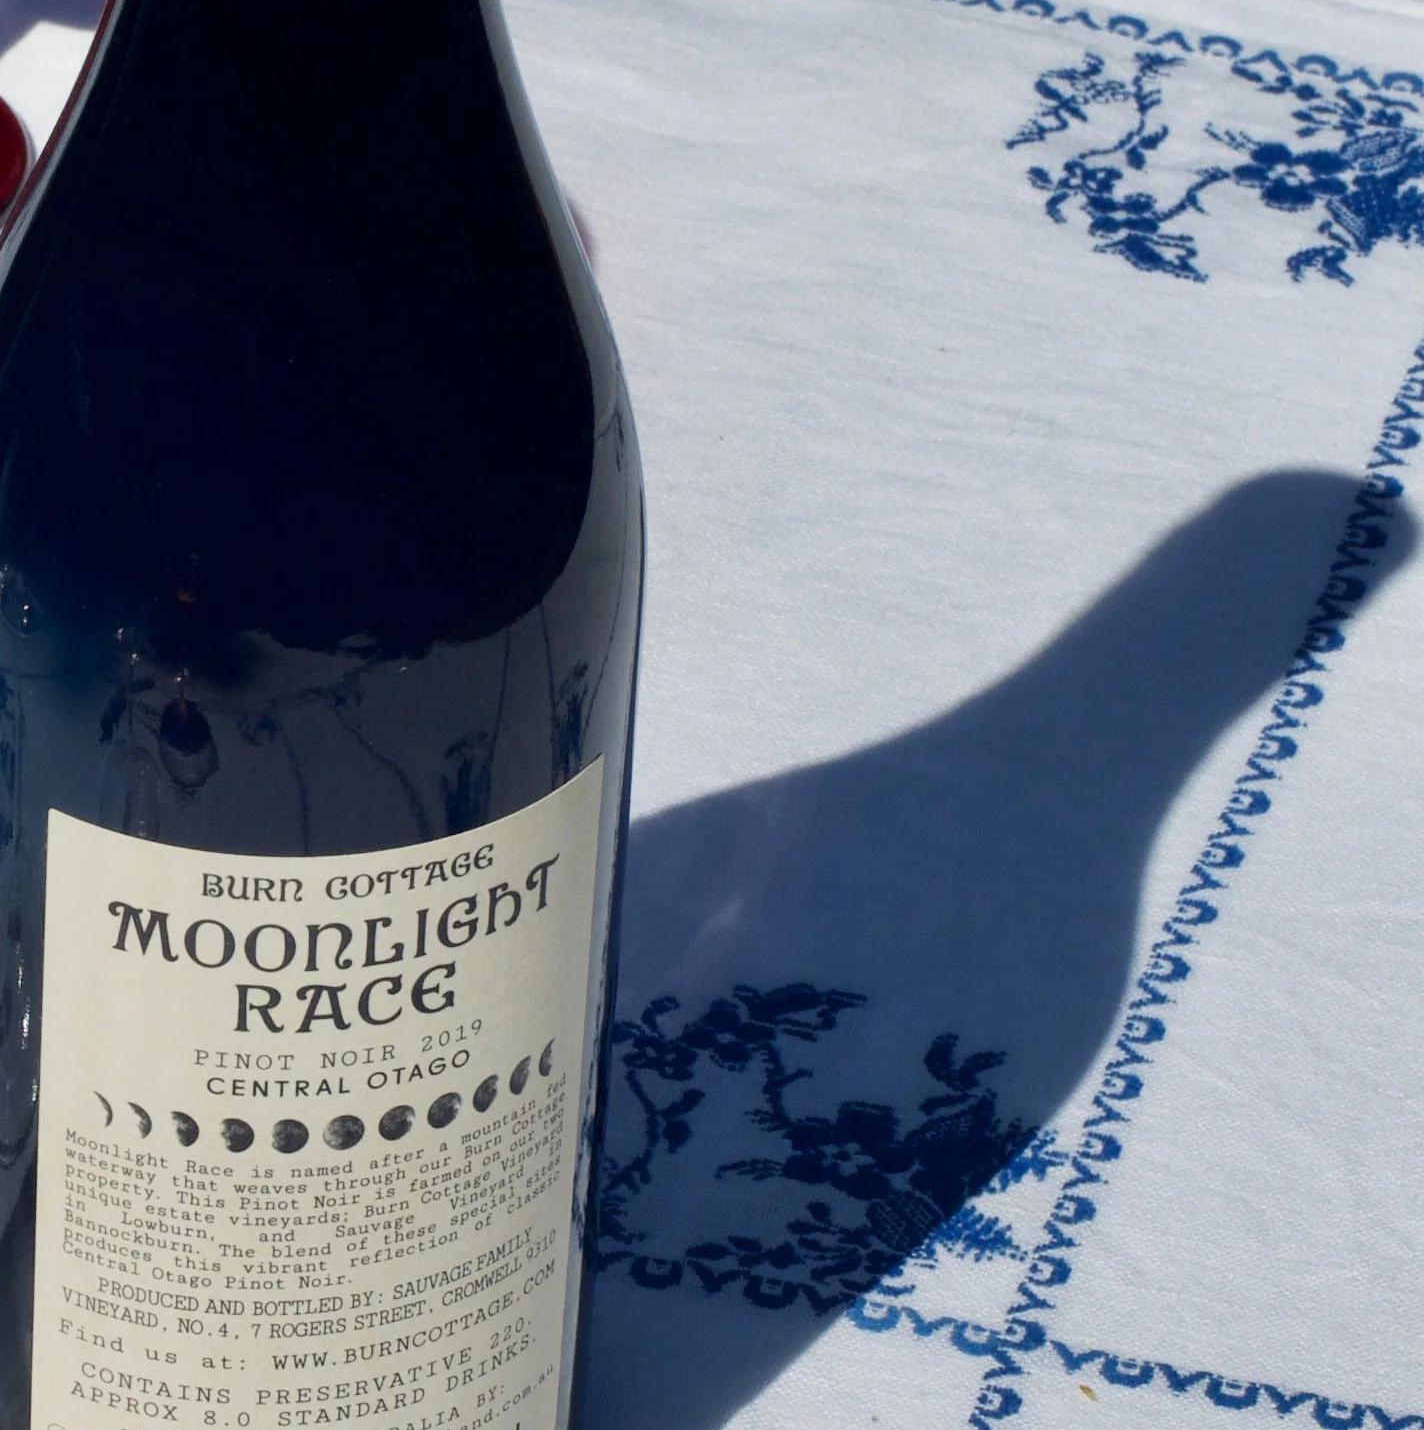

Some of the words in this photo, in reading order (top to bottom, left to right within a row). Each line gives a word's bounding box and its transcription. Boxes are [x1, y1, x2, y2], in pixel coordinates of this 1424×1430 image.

[108, 853, 560, 972] MOONLIGHT
[201, 873, 303, 902] BURN
[325, 843, 494, 899] COTTAGE
[194, 1049, 294, 1070] PINOT
[321, 1044, 396, 1069] NOIR
[422, 1019, 483, 1052] 2019
[233, 961, 456, 1034] RACE
[206, 1077, 350, 1097] CENTRAL
[367, 1049, 470, 1089] OTAGO
[65, 1129, 168, 1169] Moonlight
[187, 1160, 233, 1176] Race
[252, 1166, 274, 1178] is
[291, 1161, 353, 1178] named
[370, 1148, 424, 1170] after
[439, 1142, 448, 1152] a
[461, 1099, 536, 1144] mountain
[546, 1073, 566, 1097] fed
[65, 1147, 156, 1183] waterway
[173, 1175, 218, 1191] that
[234, 1183, 307, 1194] weaves
[324, 1169, 406, 1192] through
[419, 1157, 451, 1173] our
[464, 1136, 502, 1160] Burn
[512, 1091, 565, 1135] Cottage
[65, 1163, 161, 1201] property.
[176, 1191, 225, 1208] This
[239, 1197, 299, 1210] Pinot
[313, 1193, 361, 1209] Noir
[375, 1187, 395, 1200] is
[409, 1161, 472, 1192] farmed
[482, 1153, 500, 1166] on
[510, 1133, 535, 1152] our
[543, 1106, 564, 1130] two
[65, 1179, 132, 1209] unique
[145, 1203, 215, 1224] estate
[229, 1210, 349, 1229] vineyards;
[365, 1201, 409, 1218] Burn
[421, 1172, 491, 1204] Cottage
[501, 1120, 564, 1172] Vineyard
[65, 1194, 86, 1211] in
[121, 1211, 215, 1241] Lowburn,
[259, 1229, 295, 1242] and
[335, 1215, 415, 1238] Sauvage
[450, 1166, 524, 1210] Vineyard
[548, 1137, 562, 1156] in
[65, 1208, 201, 1255] Bannockburn.
[219, 1244, 256, 1258] The
[272, 1242, 332, 1258] blend
[346, 1238, 368, 1252] of
[384, 1224, 437, 1245] these
[450, 1188, 516, 1227] special
[526, 1154, 562, 1190] sites
[62, 1240, 141, 1276] Central
[151, 1267, 212, 1288] Otago
[224, 1275, 285, 1290] Pinot
[299, 1274, 352, 1289] Noir.
[64, 1228, 152, 1262] produces
[174, 1256, 221, 1272] this
[243, 1261, 327, 1274] vibrant
[350, 1231, 459, 1268] reflection
[474, 1214, 493, 1231] of
[506, 1170, 561, 1215] classic
[59, 1318, 124, 1353] Find
[144, 1347, 178, 1364] us
[201, 1355, 246, 1371] at:
[272, 1259, 556, 1371] WWW.BURNCOTTAGE.COM
[62, 1286, 168, 1332] VINEYARD,
[251, 1323, 262, 1338] 7
[269, 1318, 347, 1339] ROGERS
[354, 1300, 434, 1331] STREET,
[441, 1257, 522, 1307] CROMWELL
[97, 1276, 199, 1312] PRODUCED
[204, 1299, 245, 1316] AND
[252, 1296, 343, 1316] BOTTLED
[350, 1290, 384, 1309] BY:
[393, 1260, 473, 1300] SAUVAGE
[476, 1226, 533, 1271] FAMILY
[70, 1380, 178, 1422] APPROX
[203, 1410, 251, 1427] 8.0
[278, 1387, 425, 1427] STANDARD
[445, 1333, 536, 1393] DRINKS.
[81, 1362, 231, 1405] CONTAINS
[256, 1347, 473, 1405] PRESERVATIVE
[490, 1316, 532, 1350] 220.
[475, 1383, 505, 1410] BY:
